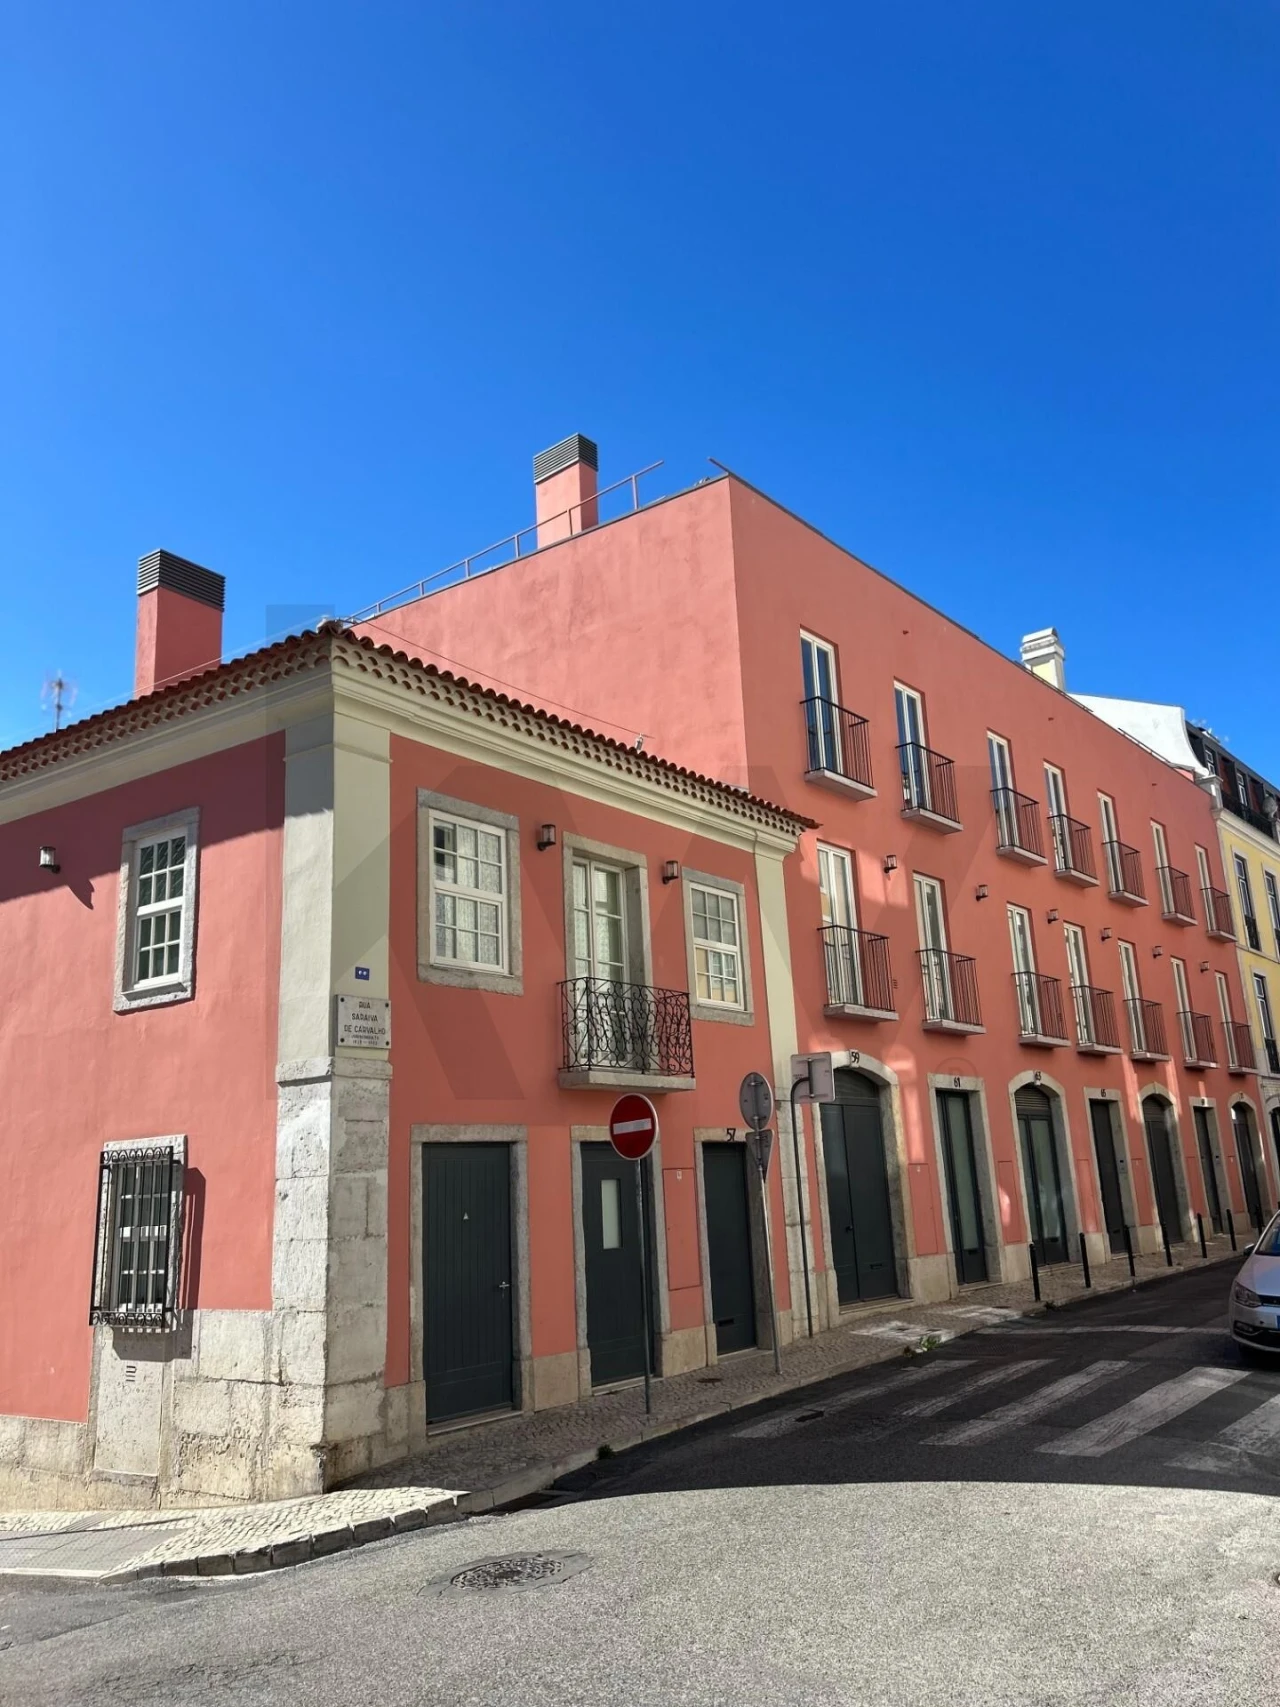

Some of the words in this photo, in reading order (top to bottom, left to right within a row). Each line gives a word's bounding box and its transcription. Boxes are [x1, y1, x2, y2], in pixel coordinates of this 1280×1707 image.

[359, 1001, 371, 1009] RUA
[351, 1013, 378, 1022] SARAIVA
[344, 1024, 352, 1033] DE
[354, 1025, 386, 1035] CARVALHO
[851, 1052, 860, 1063] 59
[953, 1076, 961, 1089] 61
[726, 1128, 736, 1142] 57
